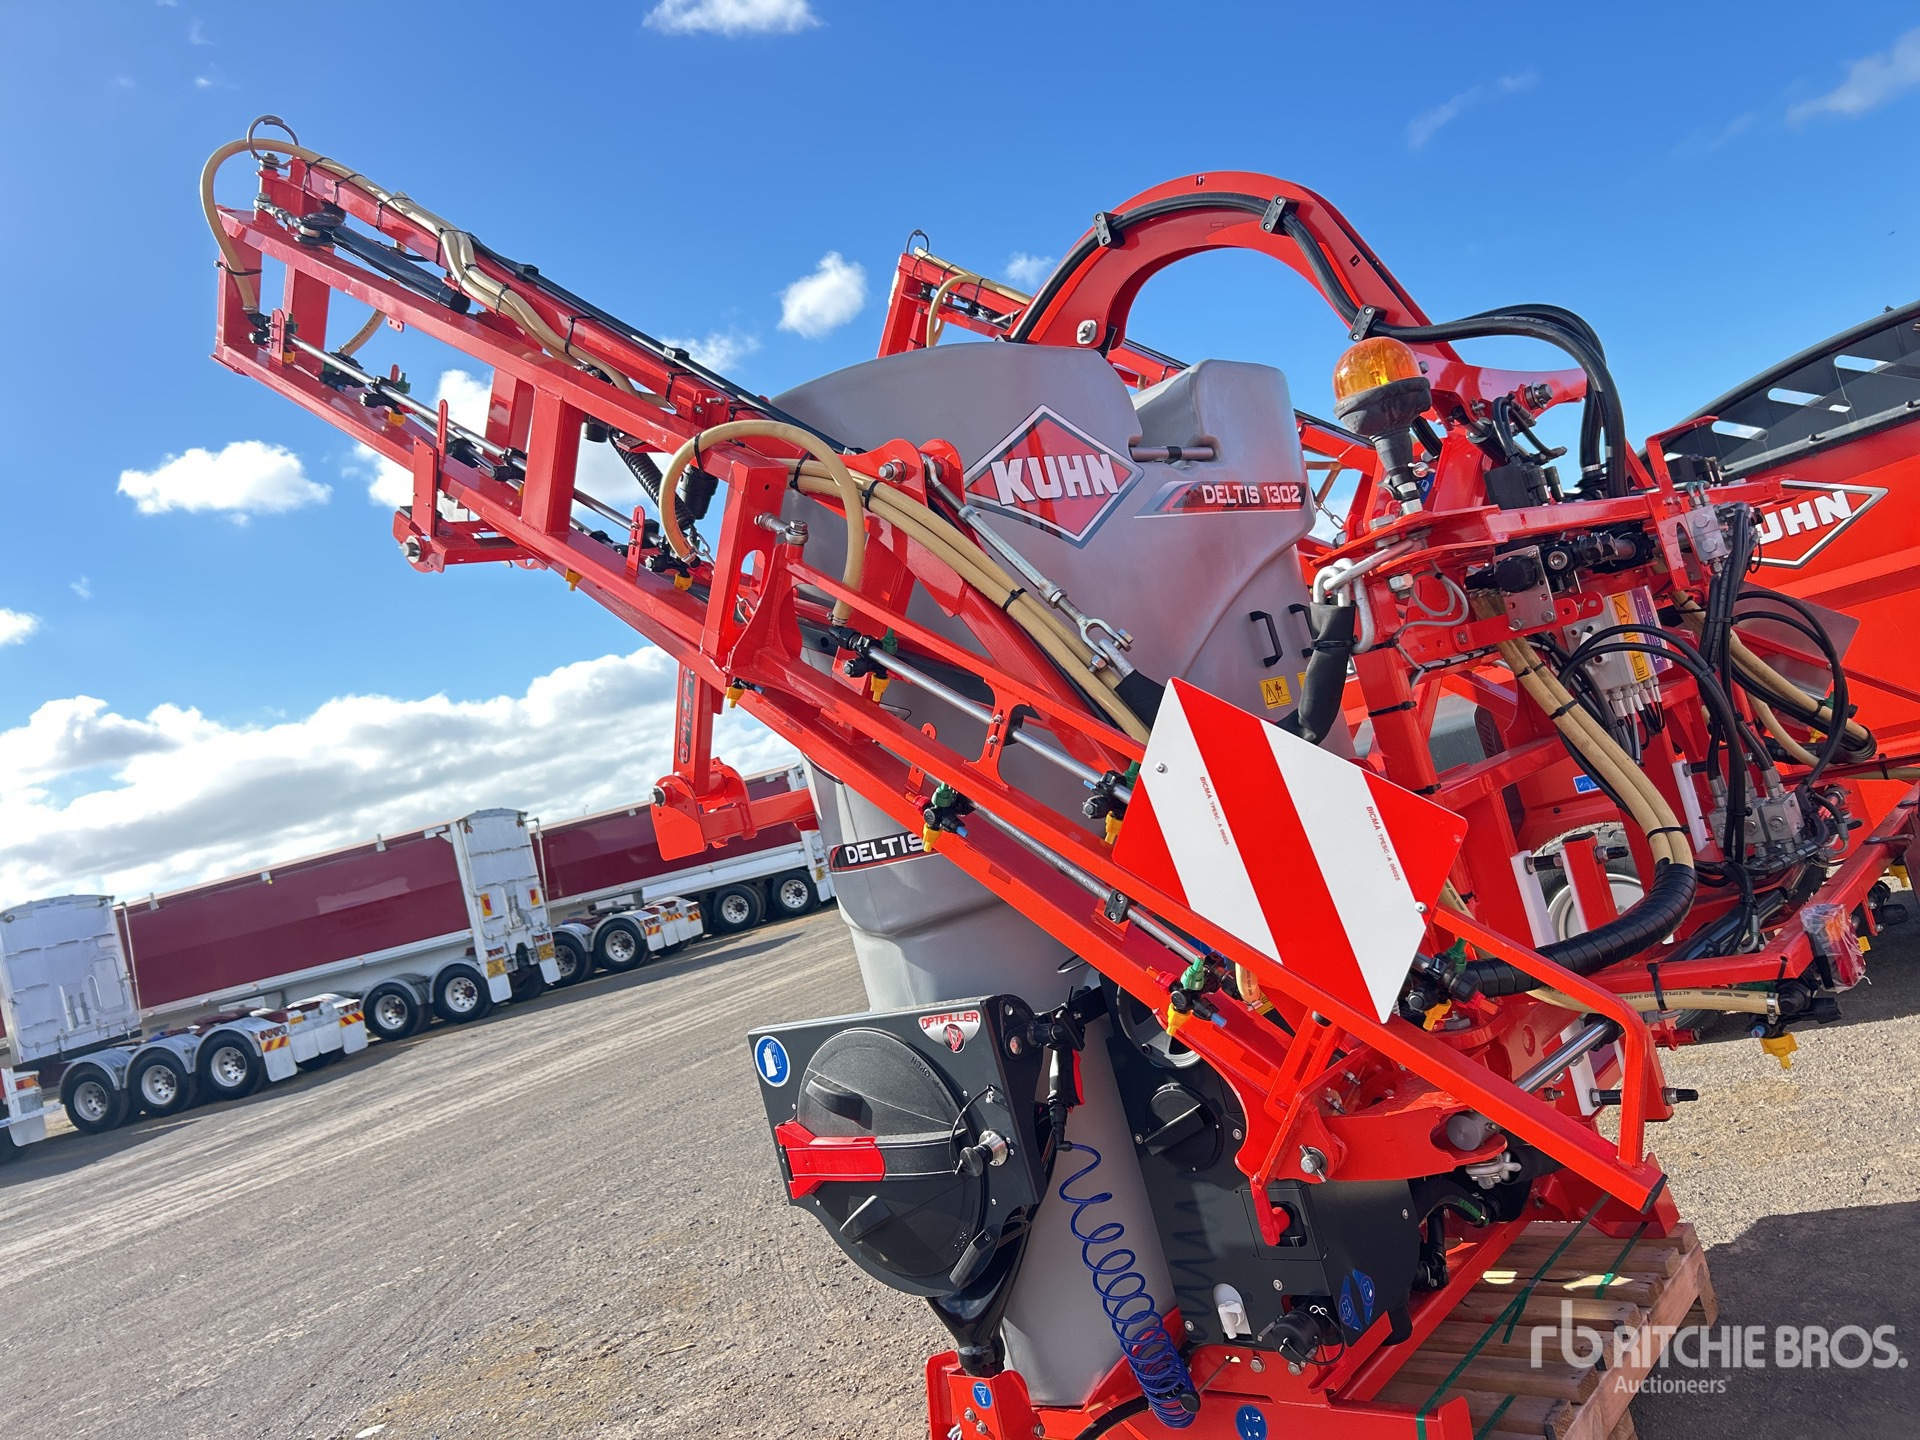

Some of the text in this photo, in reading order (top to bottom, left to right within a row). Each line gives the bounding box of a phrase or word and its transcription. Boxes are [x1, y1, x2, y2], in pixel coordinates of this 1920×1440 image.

[990, 453, 1119, 505] KUHN
[1203, 484, 1302, 504] DELTIS 1302
[1755, 489, 1852, 545] UHN
[1199, 776, 1212, 799] BICMA
[1366, 806, 1381, 830] BICMA
[844, 833, 924, 864] DELTIS
[921, 1012, 979, 1030] OPTIFILLER
[910, 1056, 931, 1078] OPEN
